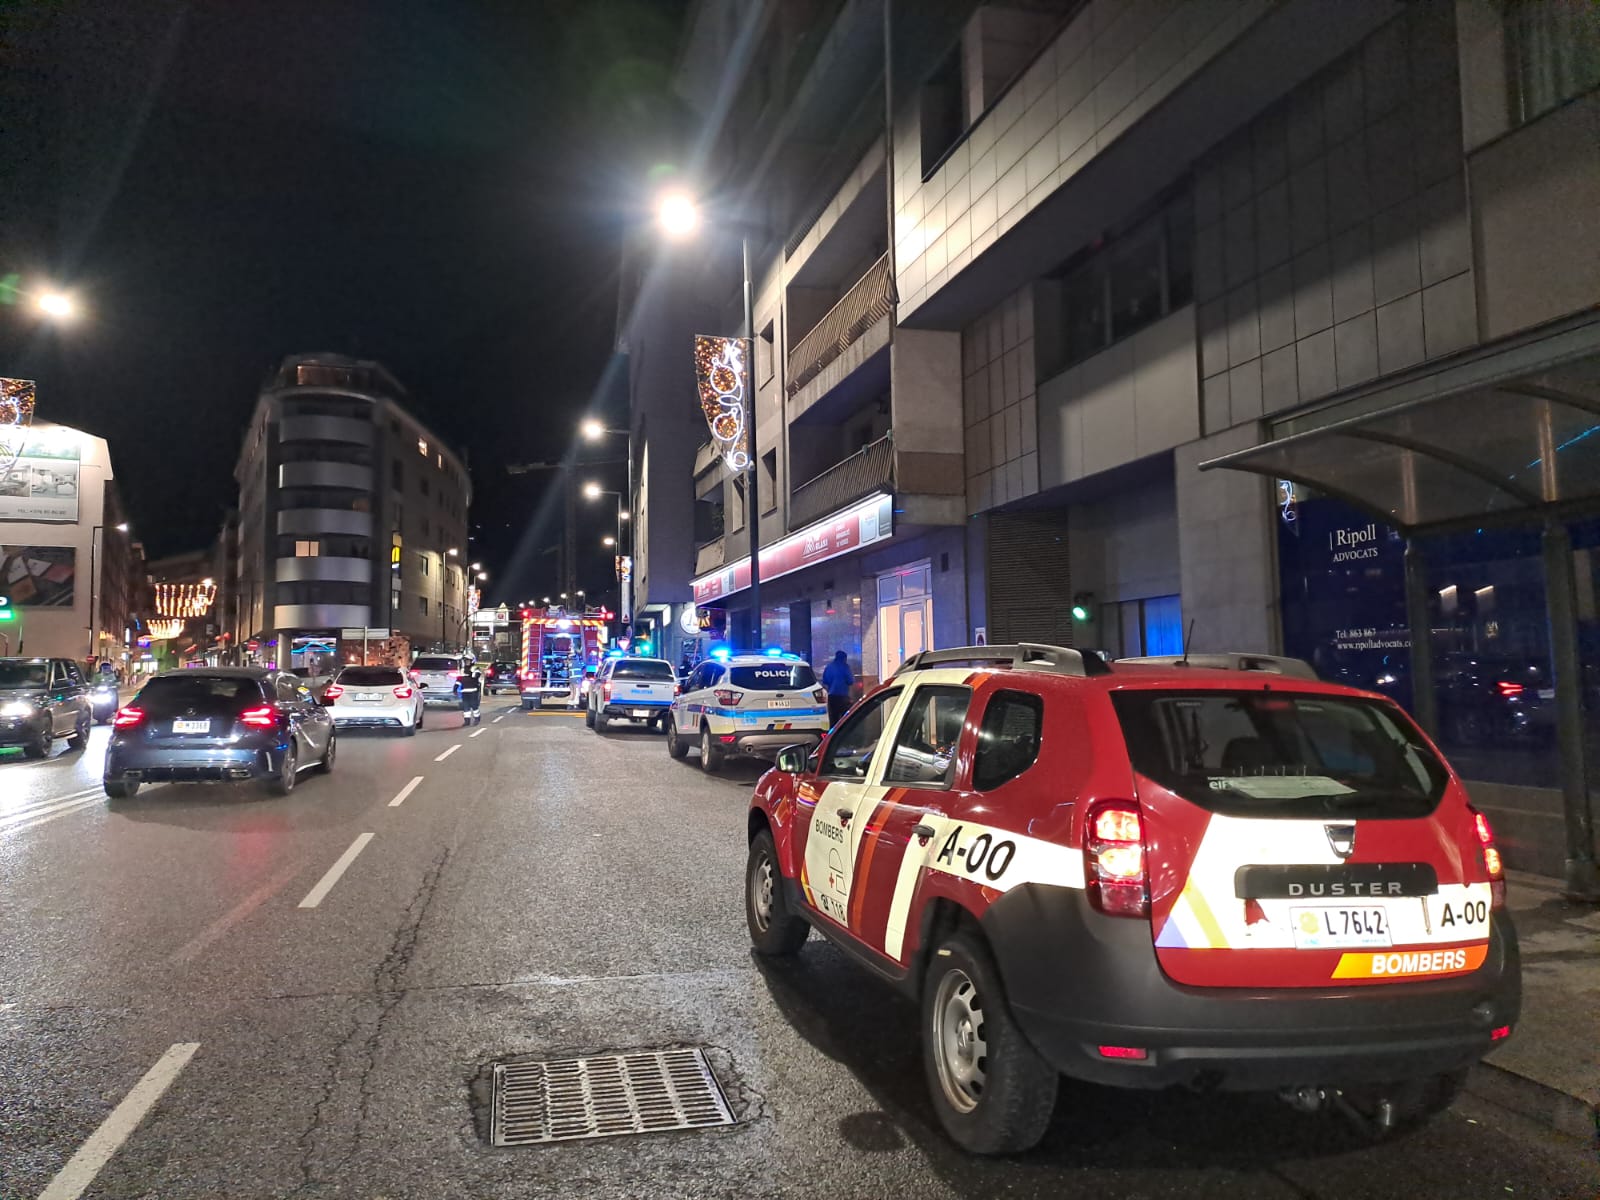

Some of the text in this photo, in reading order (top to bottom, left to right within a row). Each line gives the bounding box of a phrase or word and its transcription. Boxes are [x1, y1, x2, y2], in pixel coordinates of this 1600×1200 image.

[1336, 523, 1376, 548] Ripoll
[1333, 547, 1378, 562] ADVOCATS
[815, 819, 844, 844] BOMBERS
[936, 825, 1016, 881] A-00
[1288, 881, 1403, 896] DUSTER
[1440, 900, 1487, 927] A-00
[1371, 950, 1467, 974] BOMBERS
